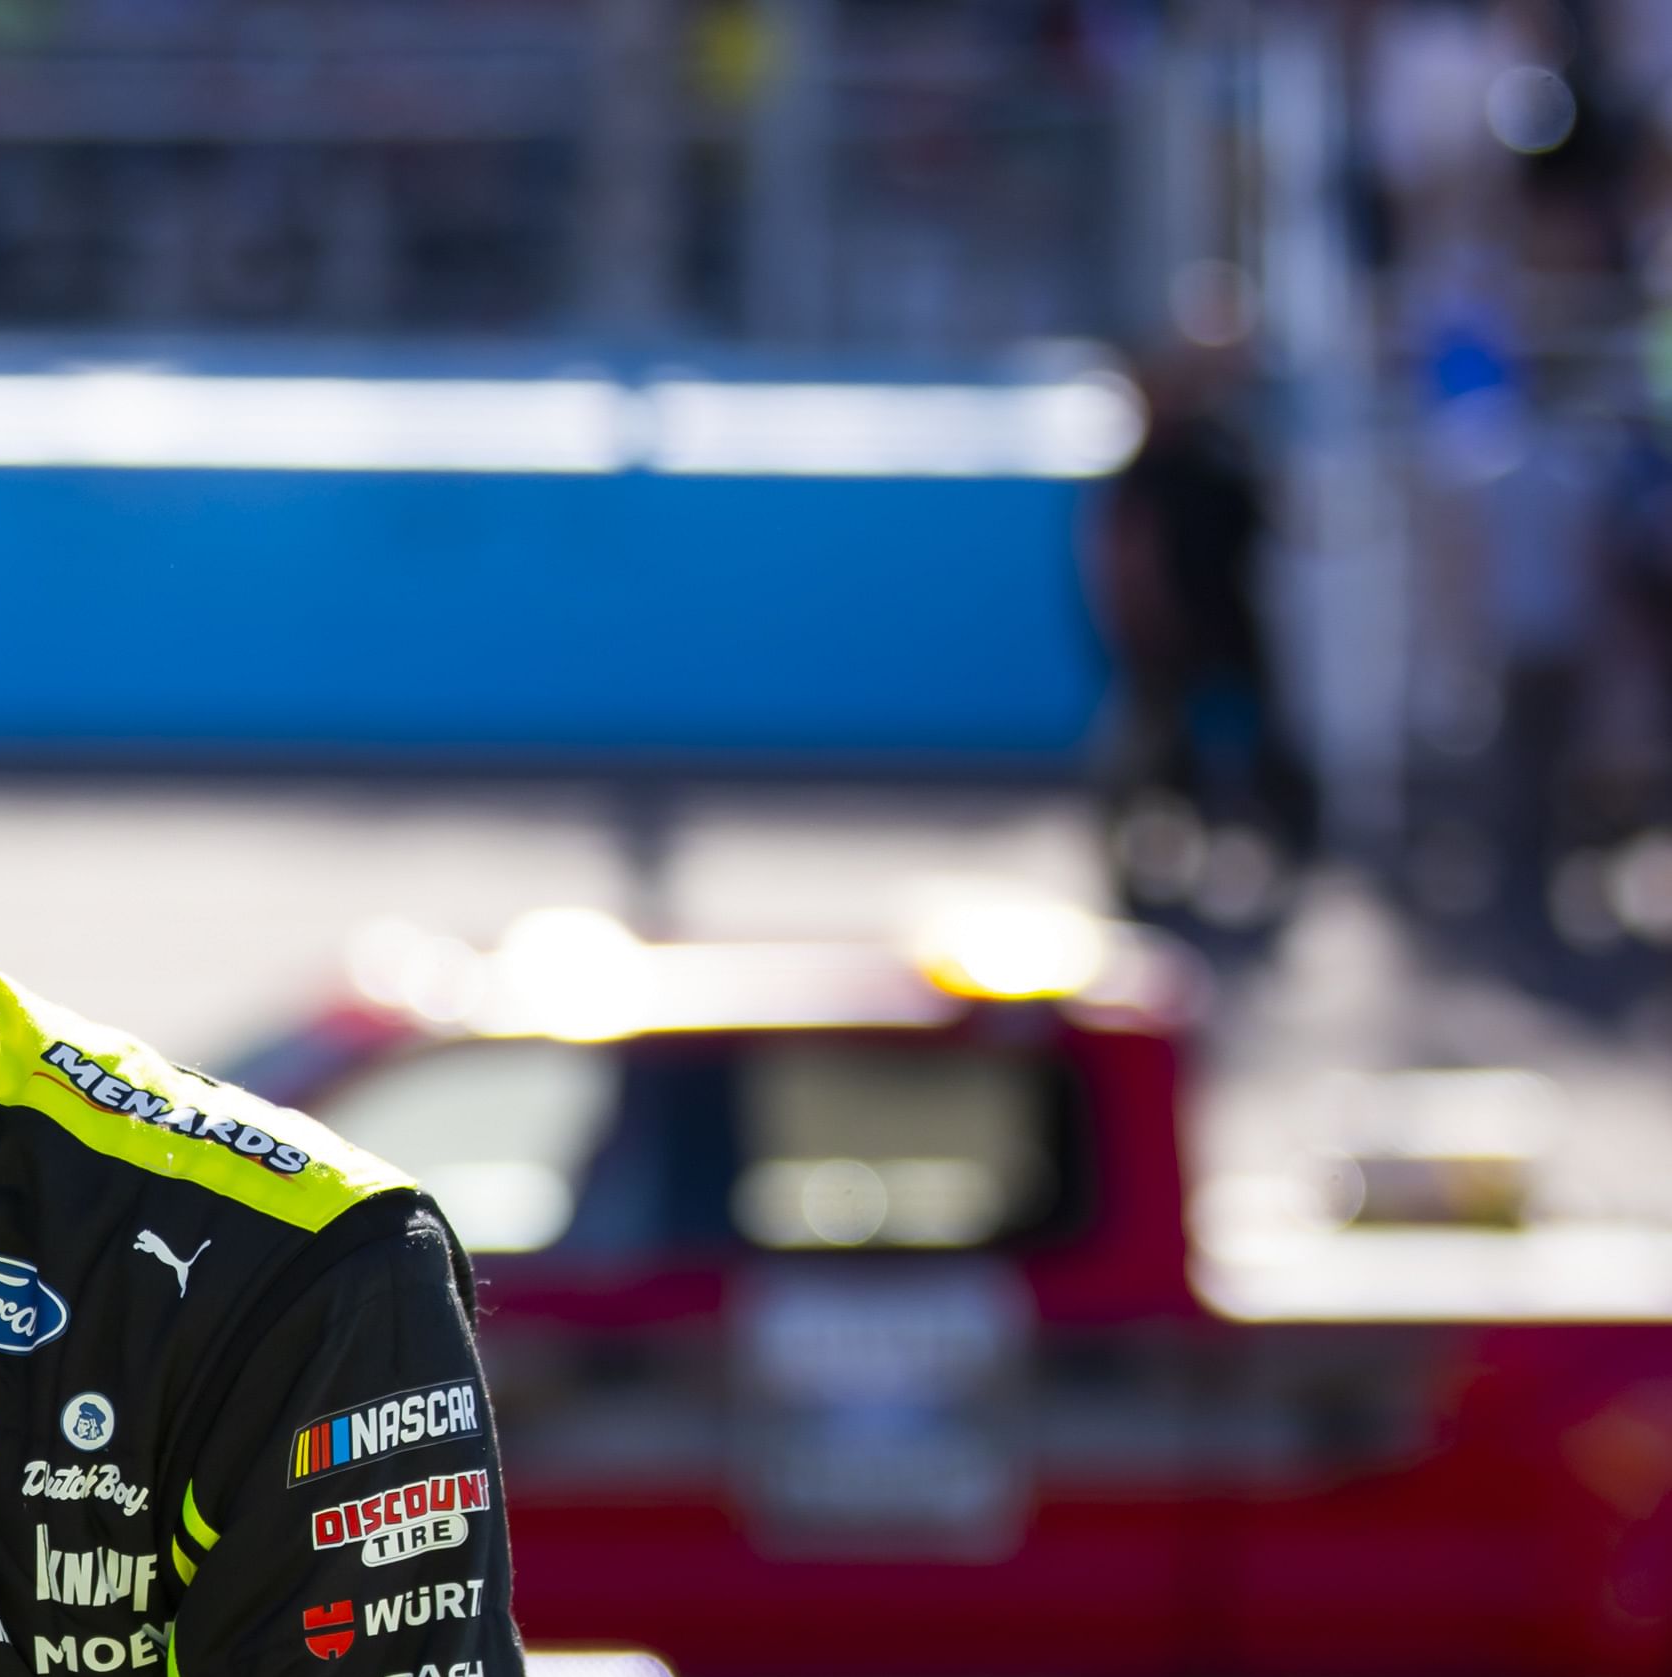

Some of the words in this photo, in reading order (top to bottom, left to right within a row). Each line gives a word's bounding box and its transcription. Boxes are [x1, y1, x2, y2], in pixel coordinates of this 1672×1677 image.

[45, 1043, 309, 1173] MENARDS
[351, 1385, 477, 1460] NASCAR
[22, 1461, 98, 1500] Dutch
[372, 1519, 452, 1558] TIRE
